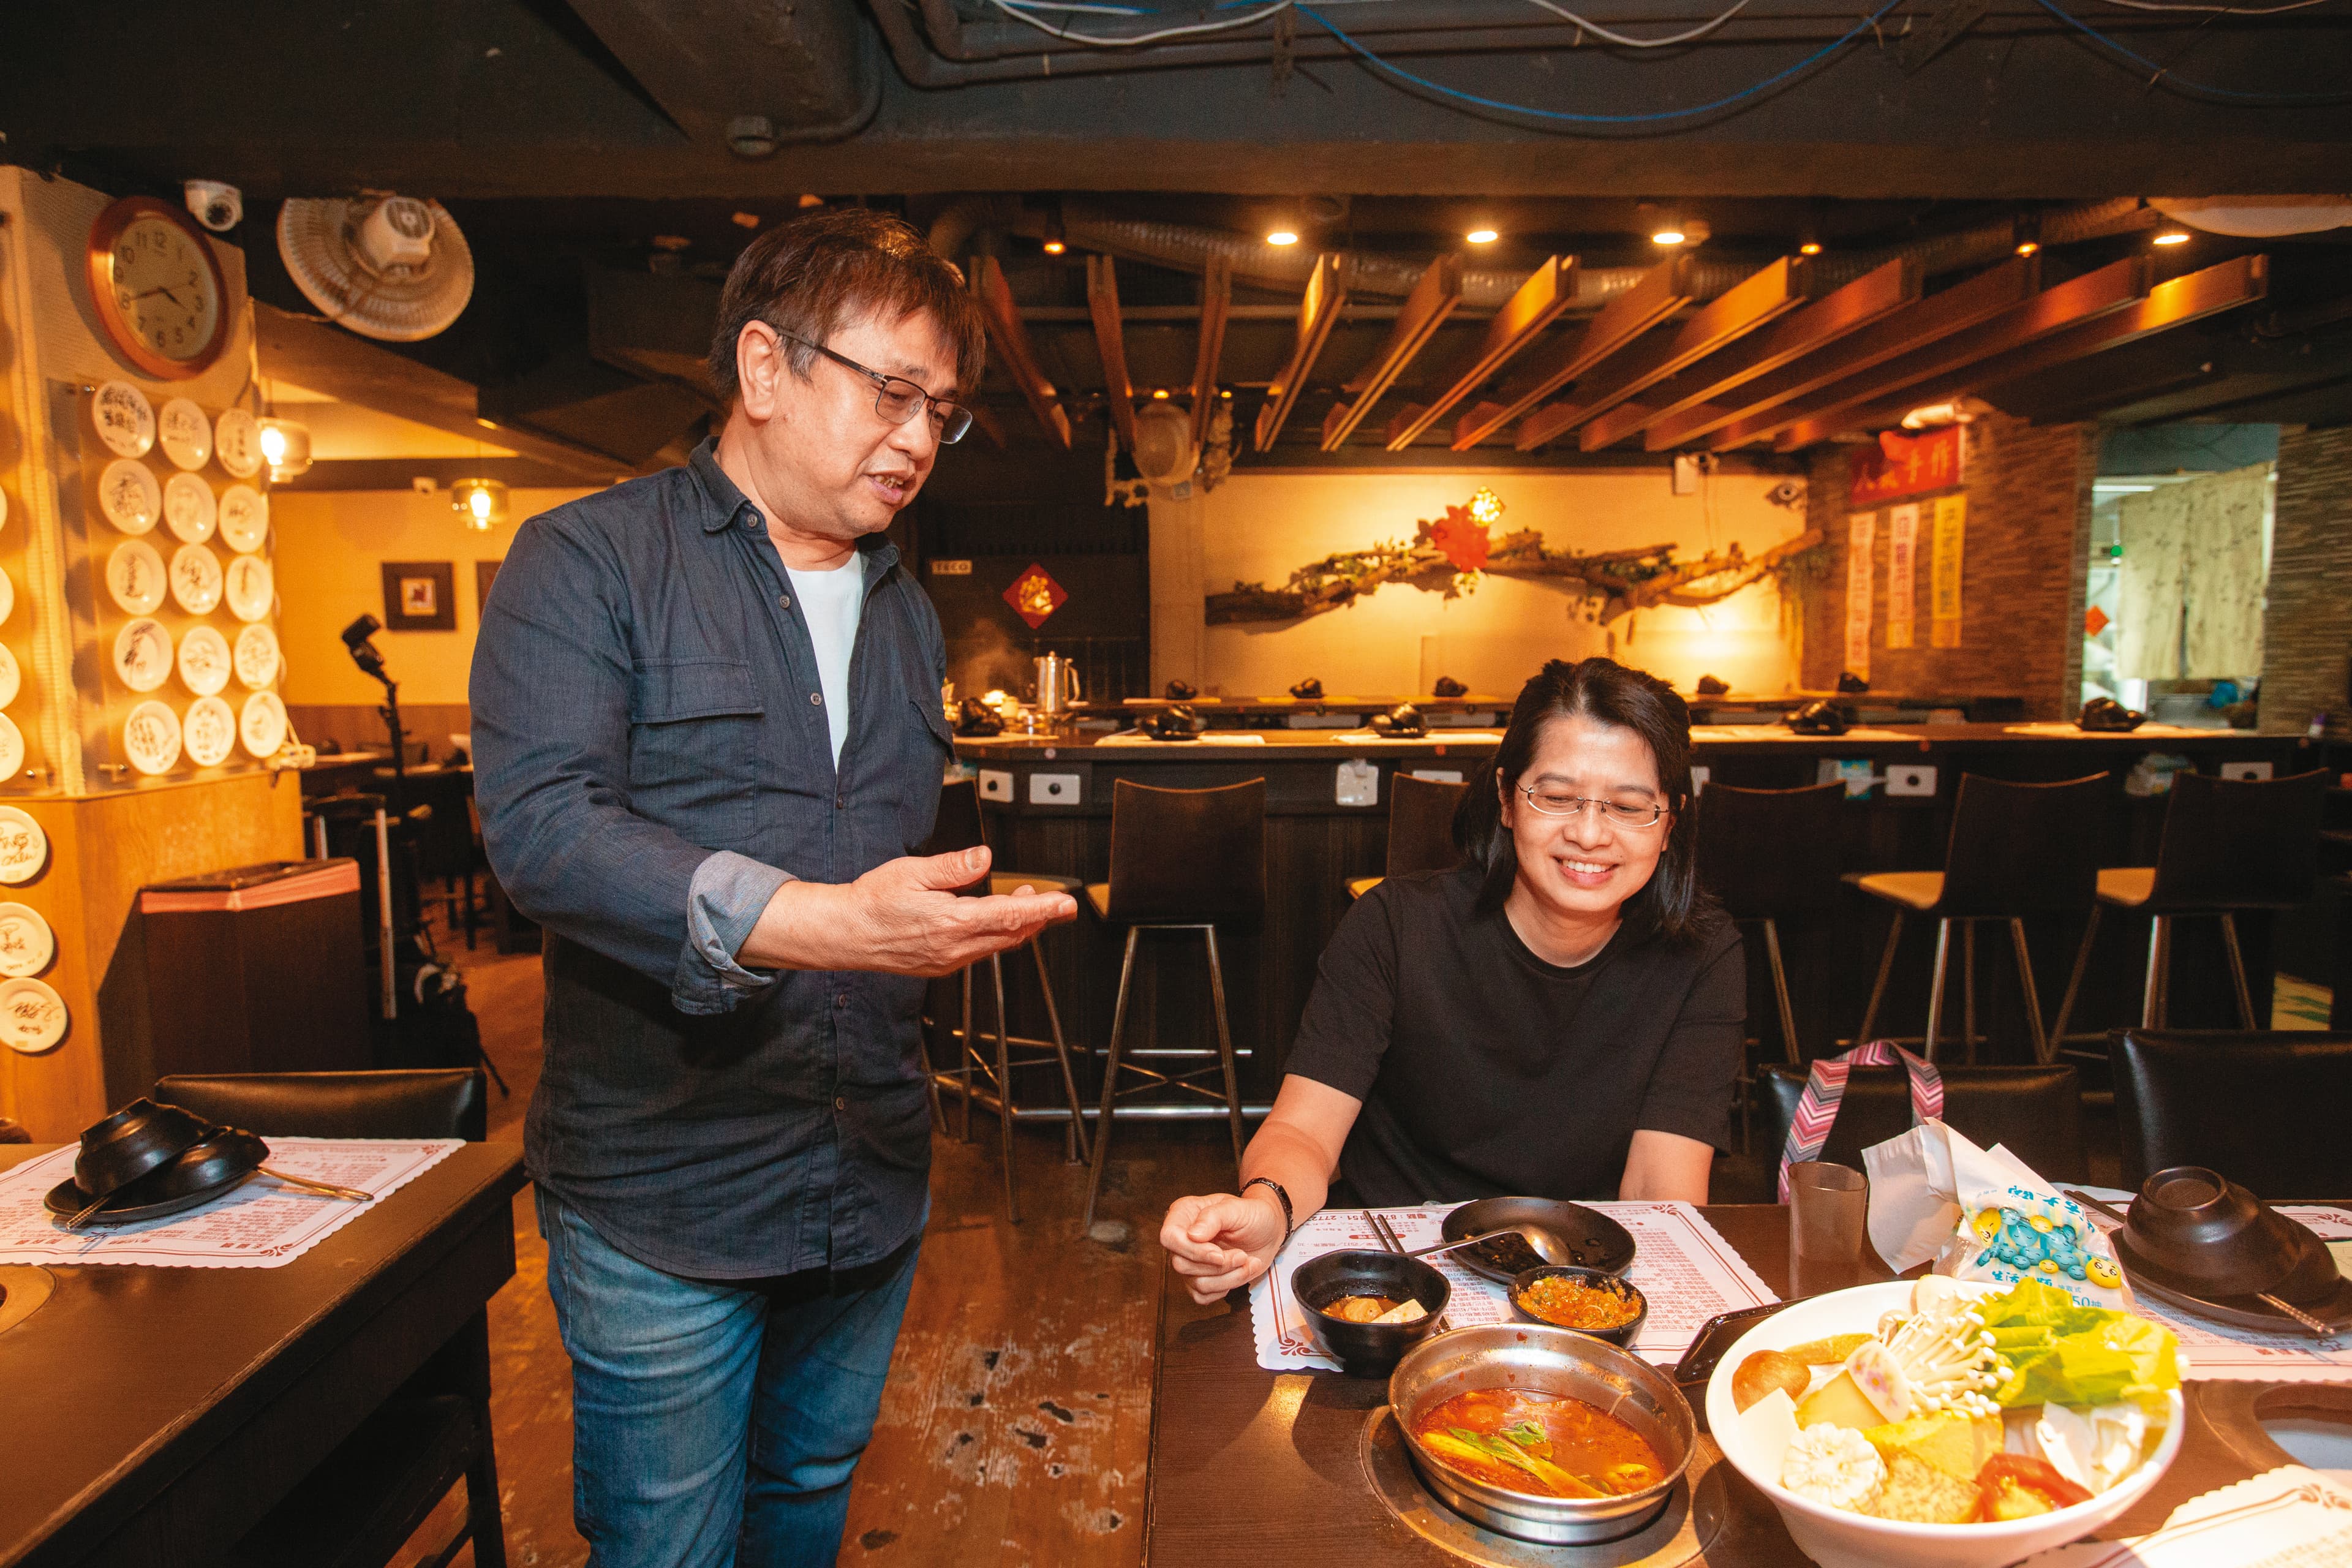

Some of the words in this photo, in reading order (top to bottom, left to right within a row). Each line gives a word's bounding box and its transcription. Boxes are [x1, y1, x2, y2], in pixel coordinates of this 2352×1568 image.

[154, 230, 166, 249] 12
[121, 245, 135, 264] 10
[188, 271, 198, 287] 2
[120, 292, 131, 309] 8
